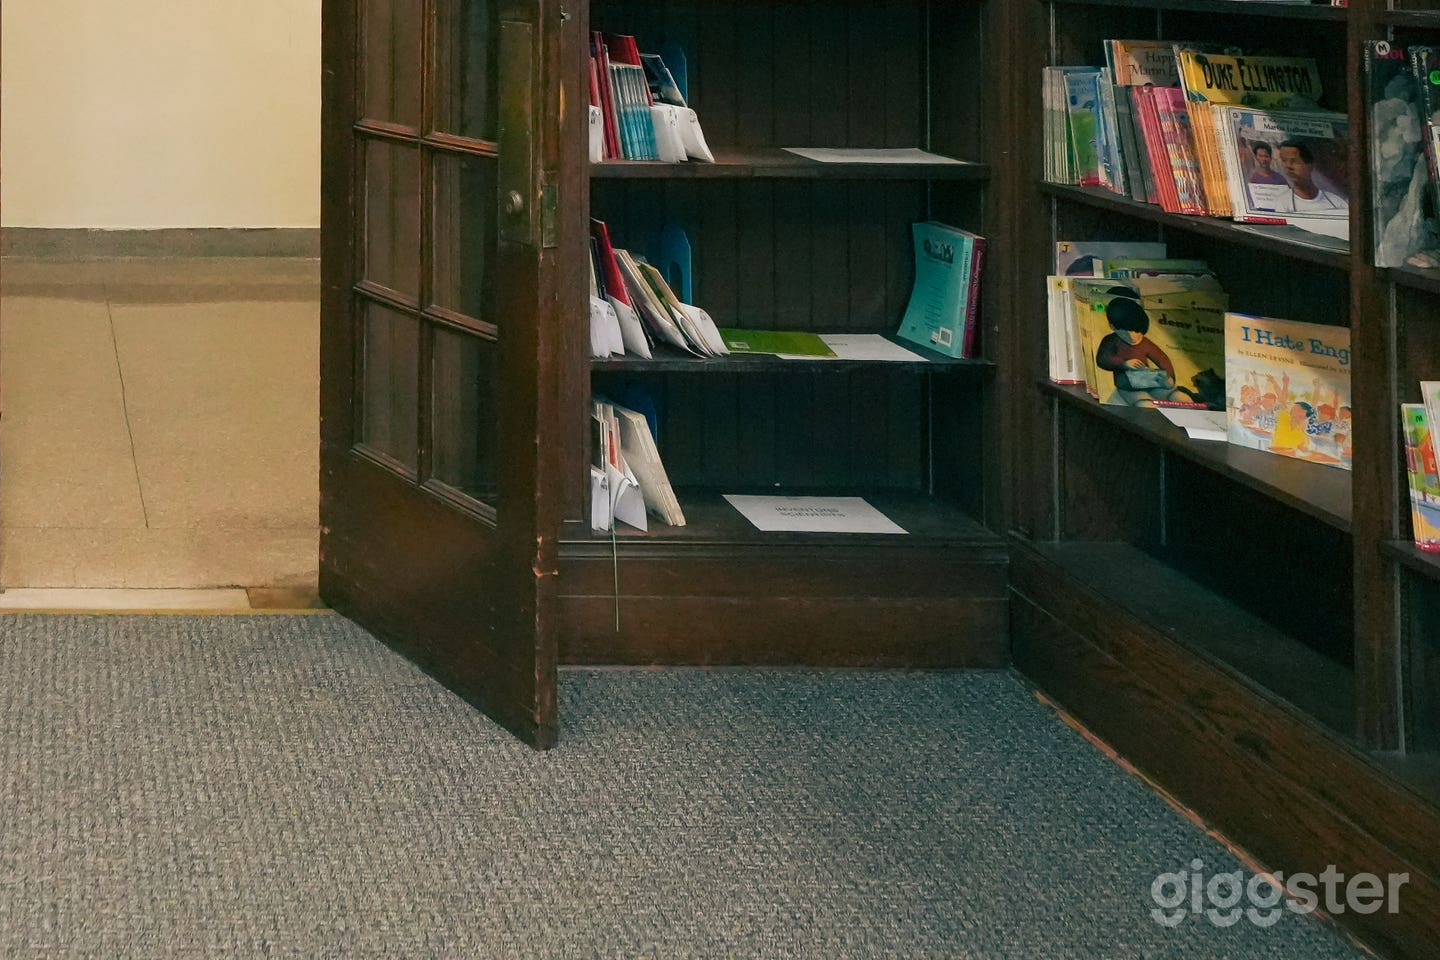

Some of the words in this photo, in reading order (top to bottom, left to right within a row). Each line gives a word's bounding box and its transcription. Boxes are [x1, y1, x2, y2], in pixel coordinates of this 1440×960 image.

[1202, 55, 1238, 90] DUKE
[1236, 58, 1312, 93] ELLINGTON
[1241, 326, 1251, 342] I
[1255, 330, 1304, 351] Hate
[1308, 338, 1350, 366] Eng
